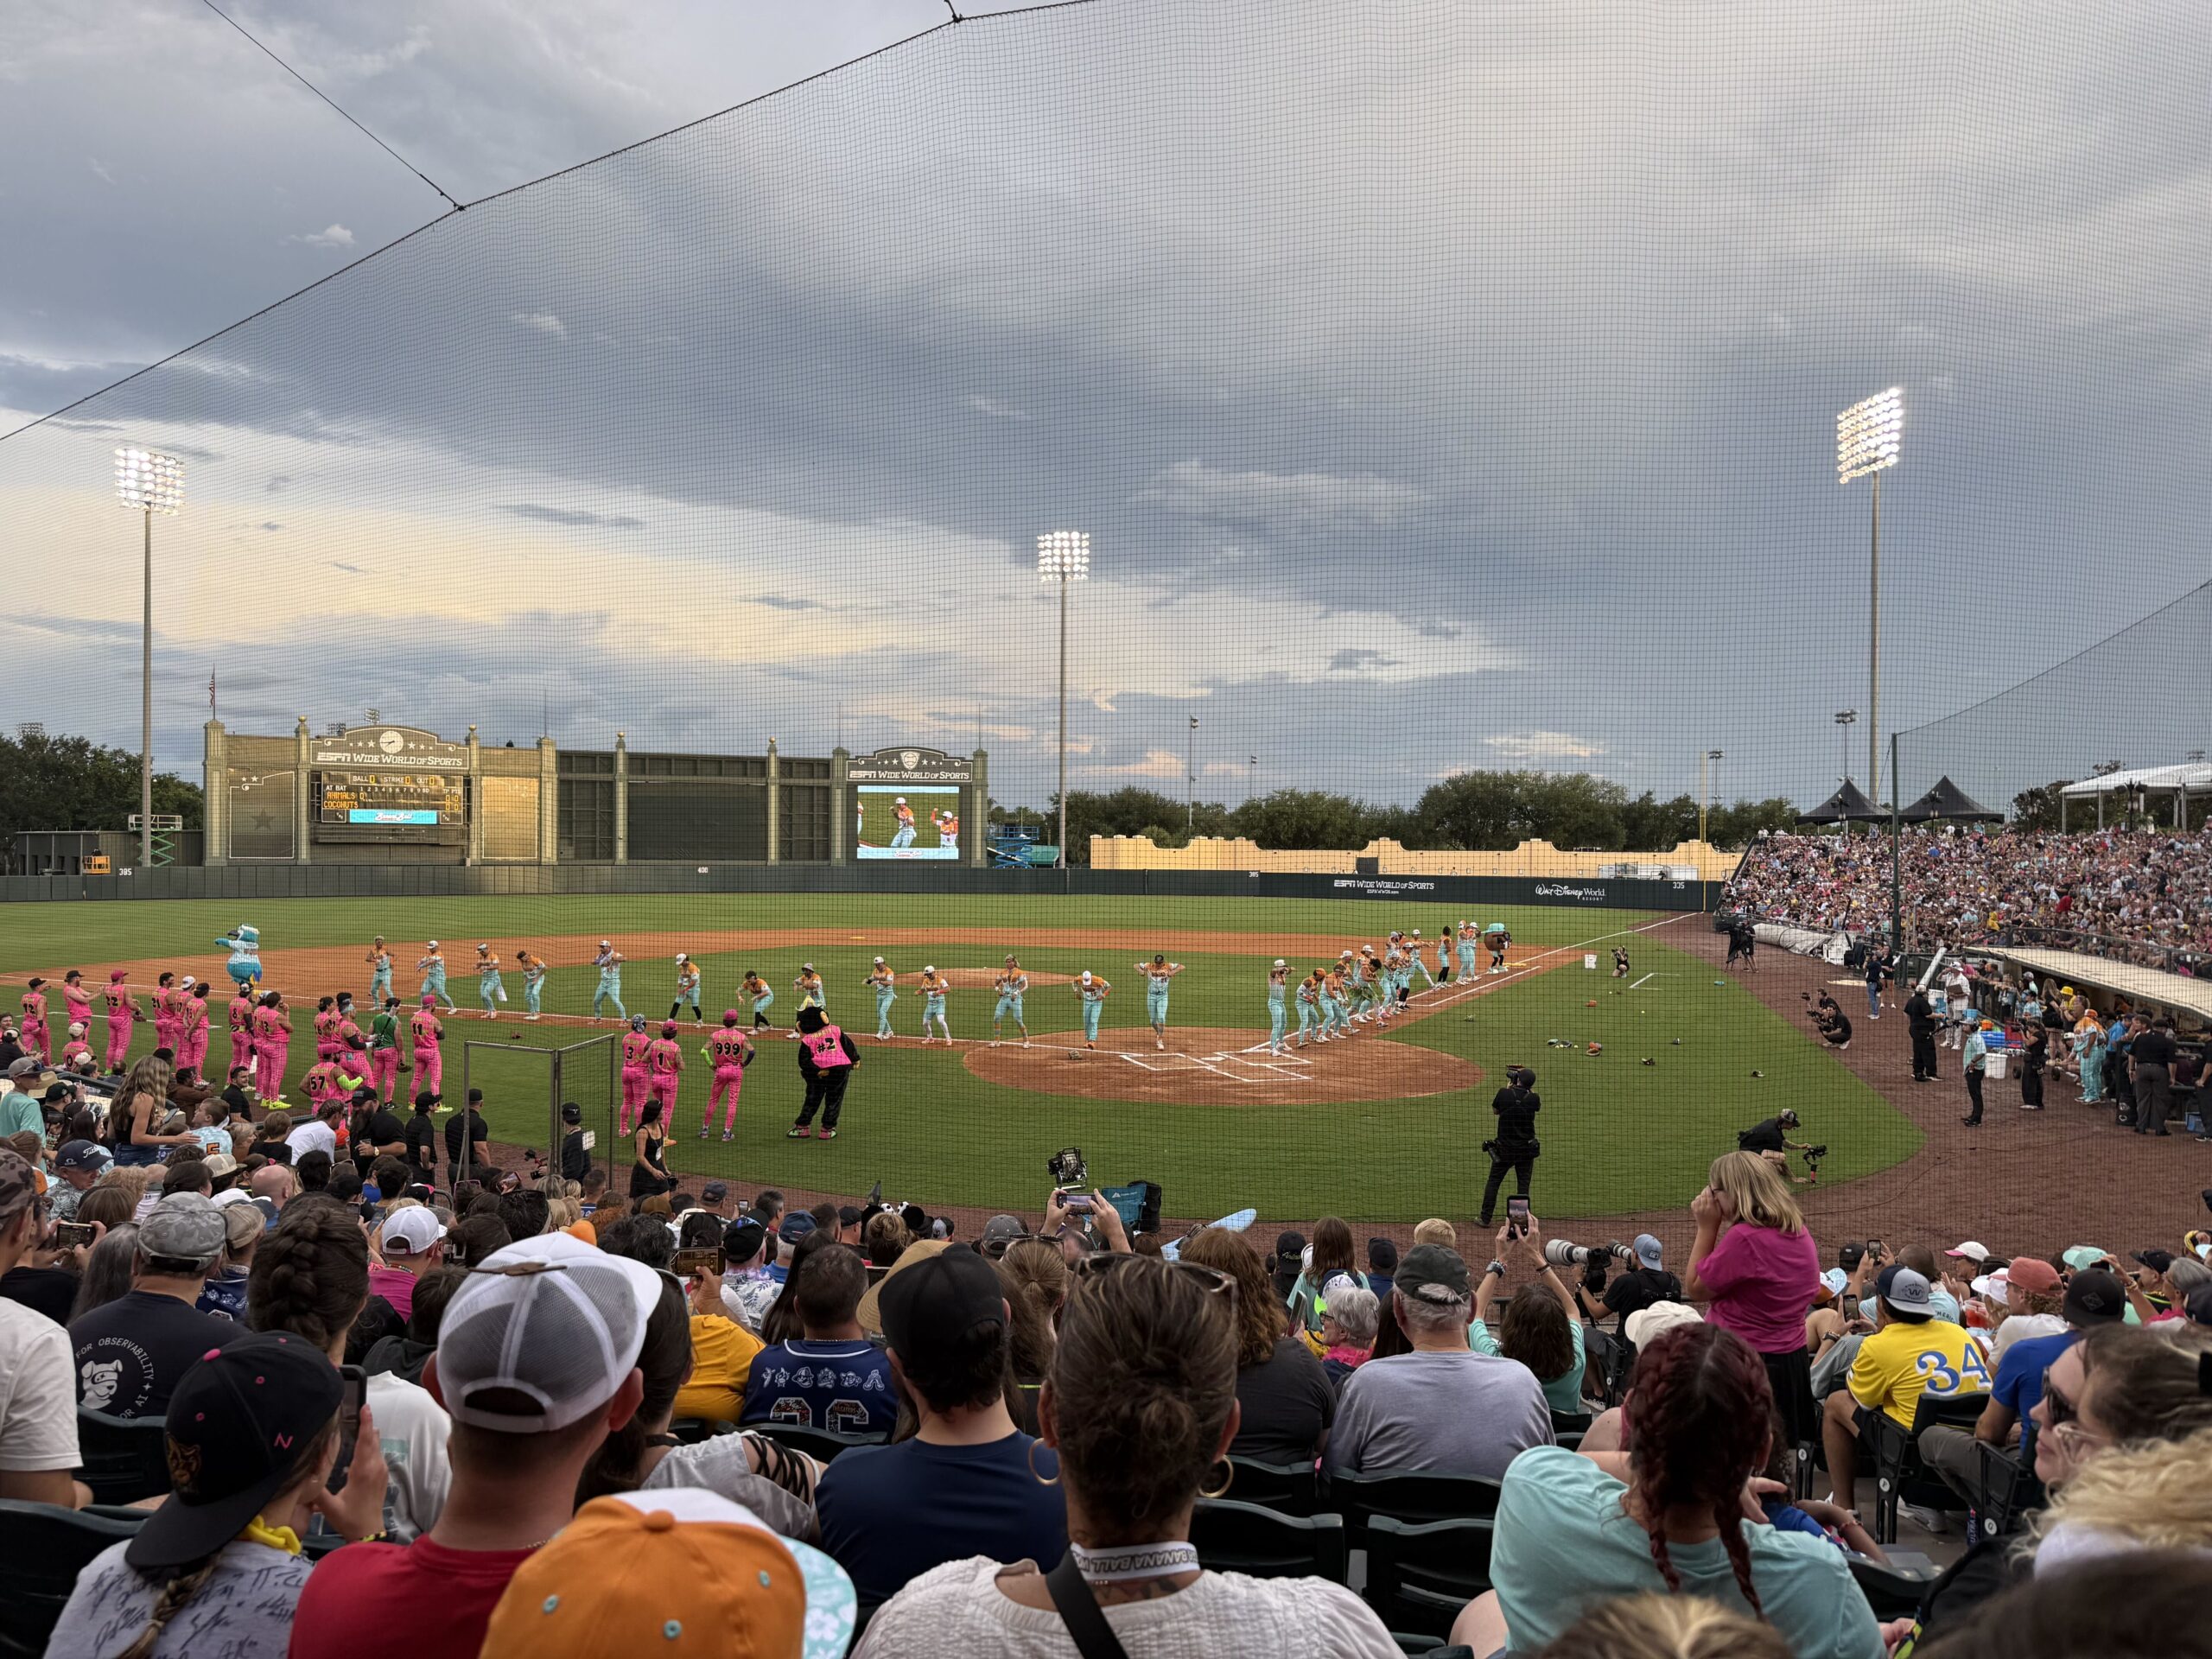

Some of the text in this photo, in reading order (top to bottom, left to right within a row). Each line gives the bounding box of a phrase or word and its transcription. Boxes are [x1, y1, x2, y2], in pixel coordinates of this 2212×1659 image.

[317, 753, 351, 762] ESPN
[353, 753, 380, 763] WIDE
[381, 754, 416, 764] WORLD
[427, 756, 462, 766] SPORTS
[878, 771, 899, 779] WIDE
[118, 868, 132, 876] 385
[1333, 880, 1356, 888] ESPN
[412, 1022, 423, 1035] 11
[715, 1042, 741, 1056] 999
[817, 1037, 836, 1053] #2
[626, 1046, 634, 1060] 3
[657, 1052, 664, 1066] 1
[310, 1076, 326, 1090] 57
[75, 1337, 155, 1381] FOR OBSERVABILITY
[1916, 1342, 1992, 1396] 34
[135, 1394, 149, 1408] AI
[1090, 1555, 1133, 1573] BALL
[1134, 1548, 1188, 1571] BANANA
